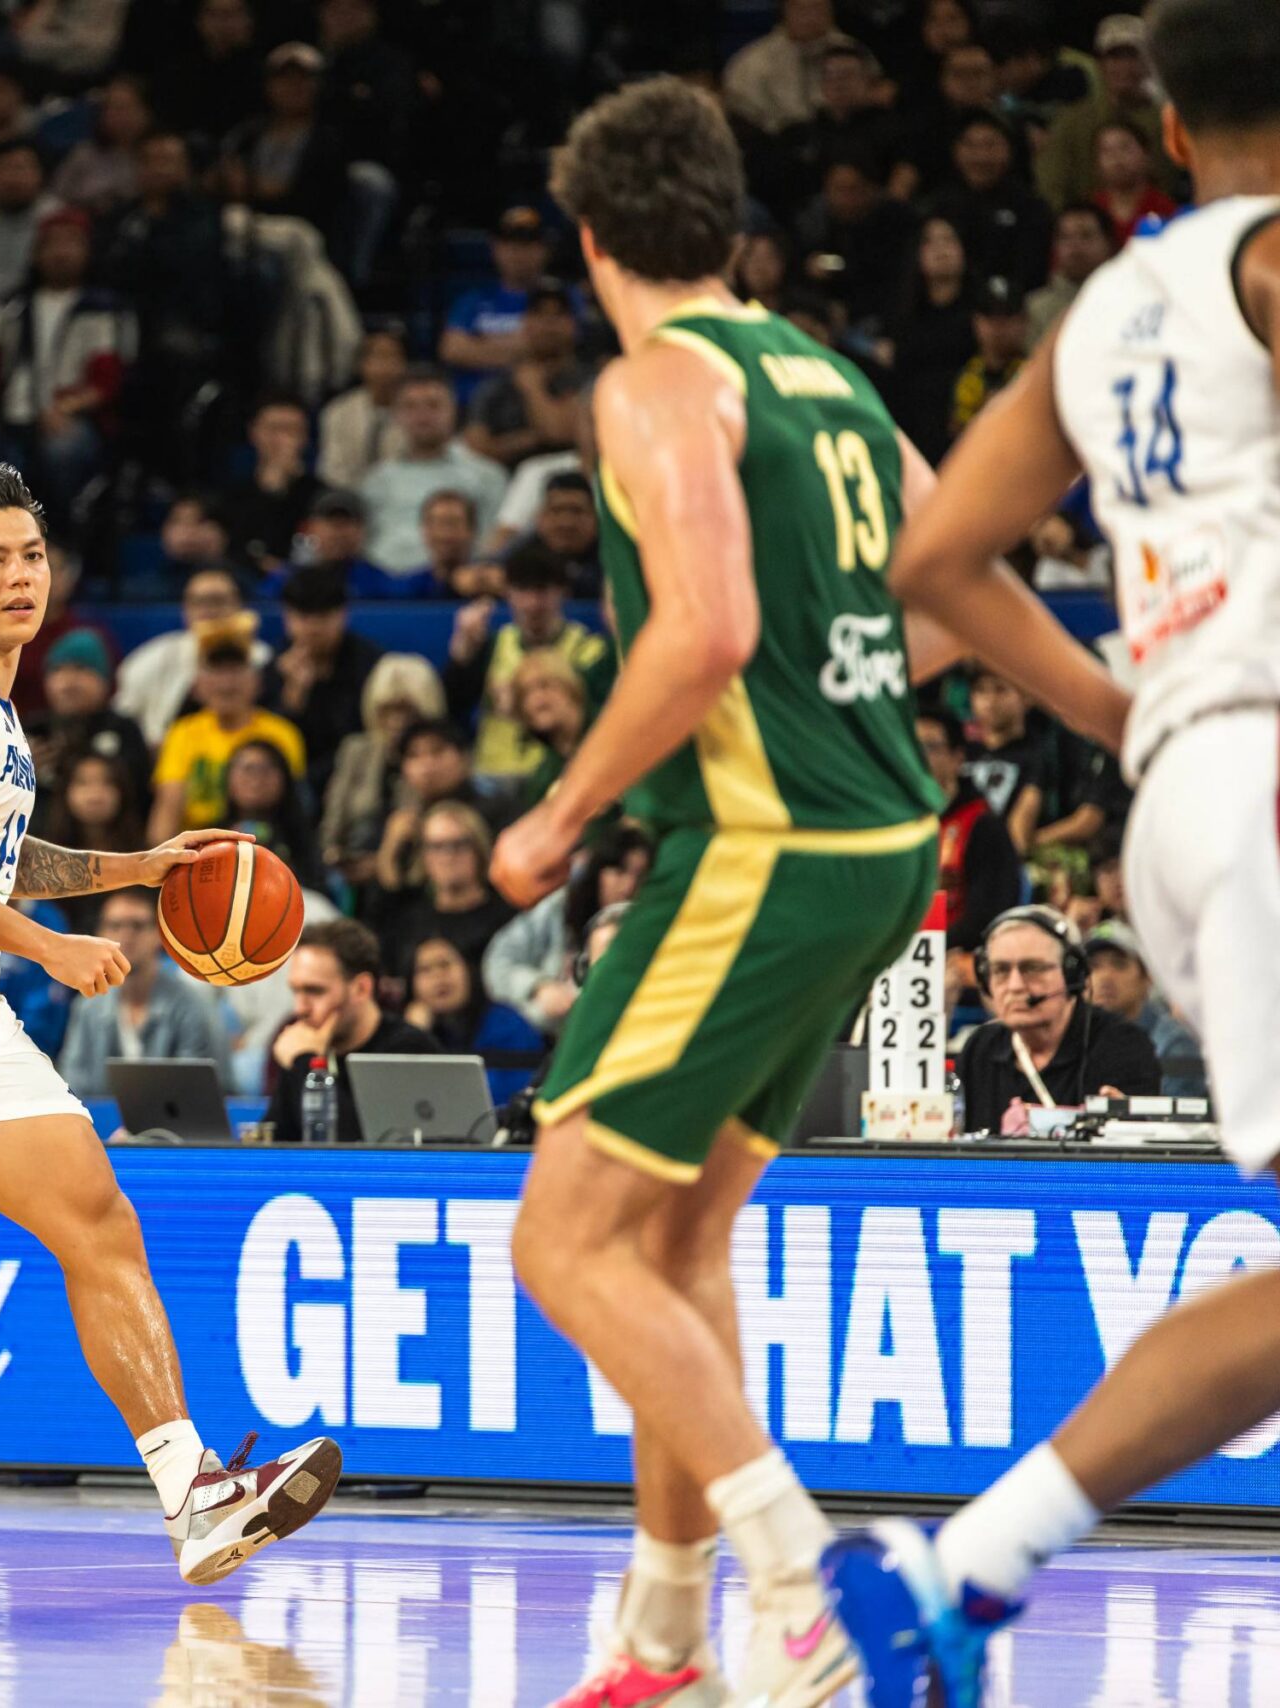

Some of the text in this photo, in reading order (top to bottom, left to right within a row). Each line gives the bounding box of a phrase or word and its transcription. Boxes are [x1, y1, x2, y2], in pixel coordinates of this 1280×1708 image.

[813, 429, 889, 572] 13
[912, 938, 934, 967] 4
[880, 977, 931, 1008] 3 3
[882, 1018, 936, 1048] 2 2
[882, 1059, 928, 1088] 1 1
[236, 1194, 522, 1432] GET
[587, 1204, 1038, 1448] HAT
